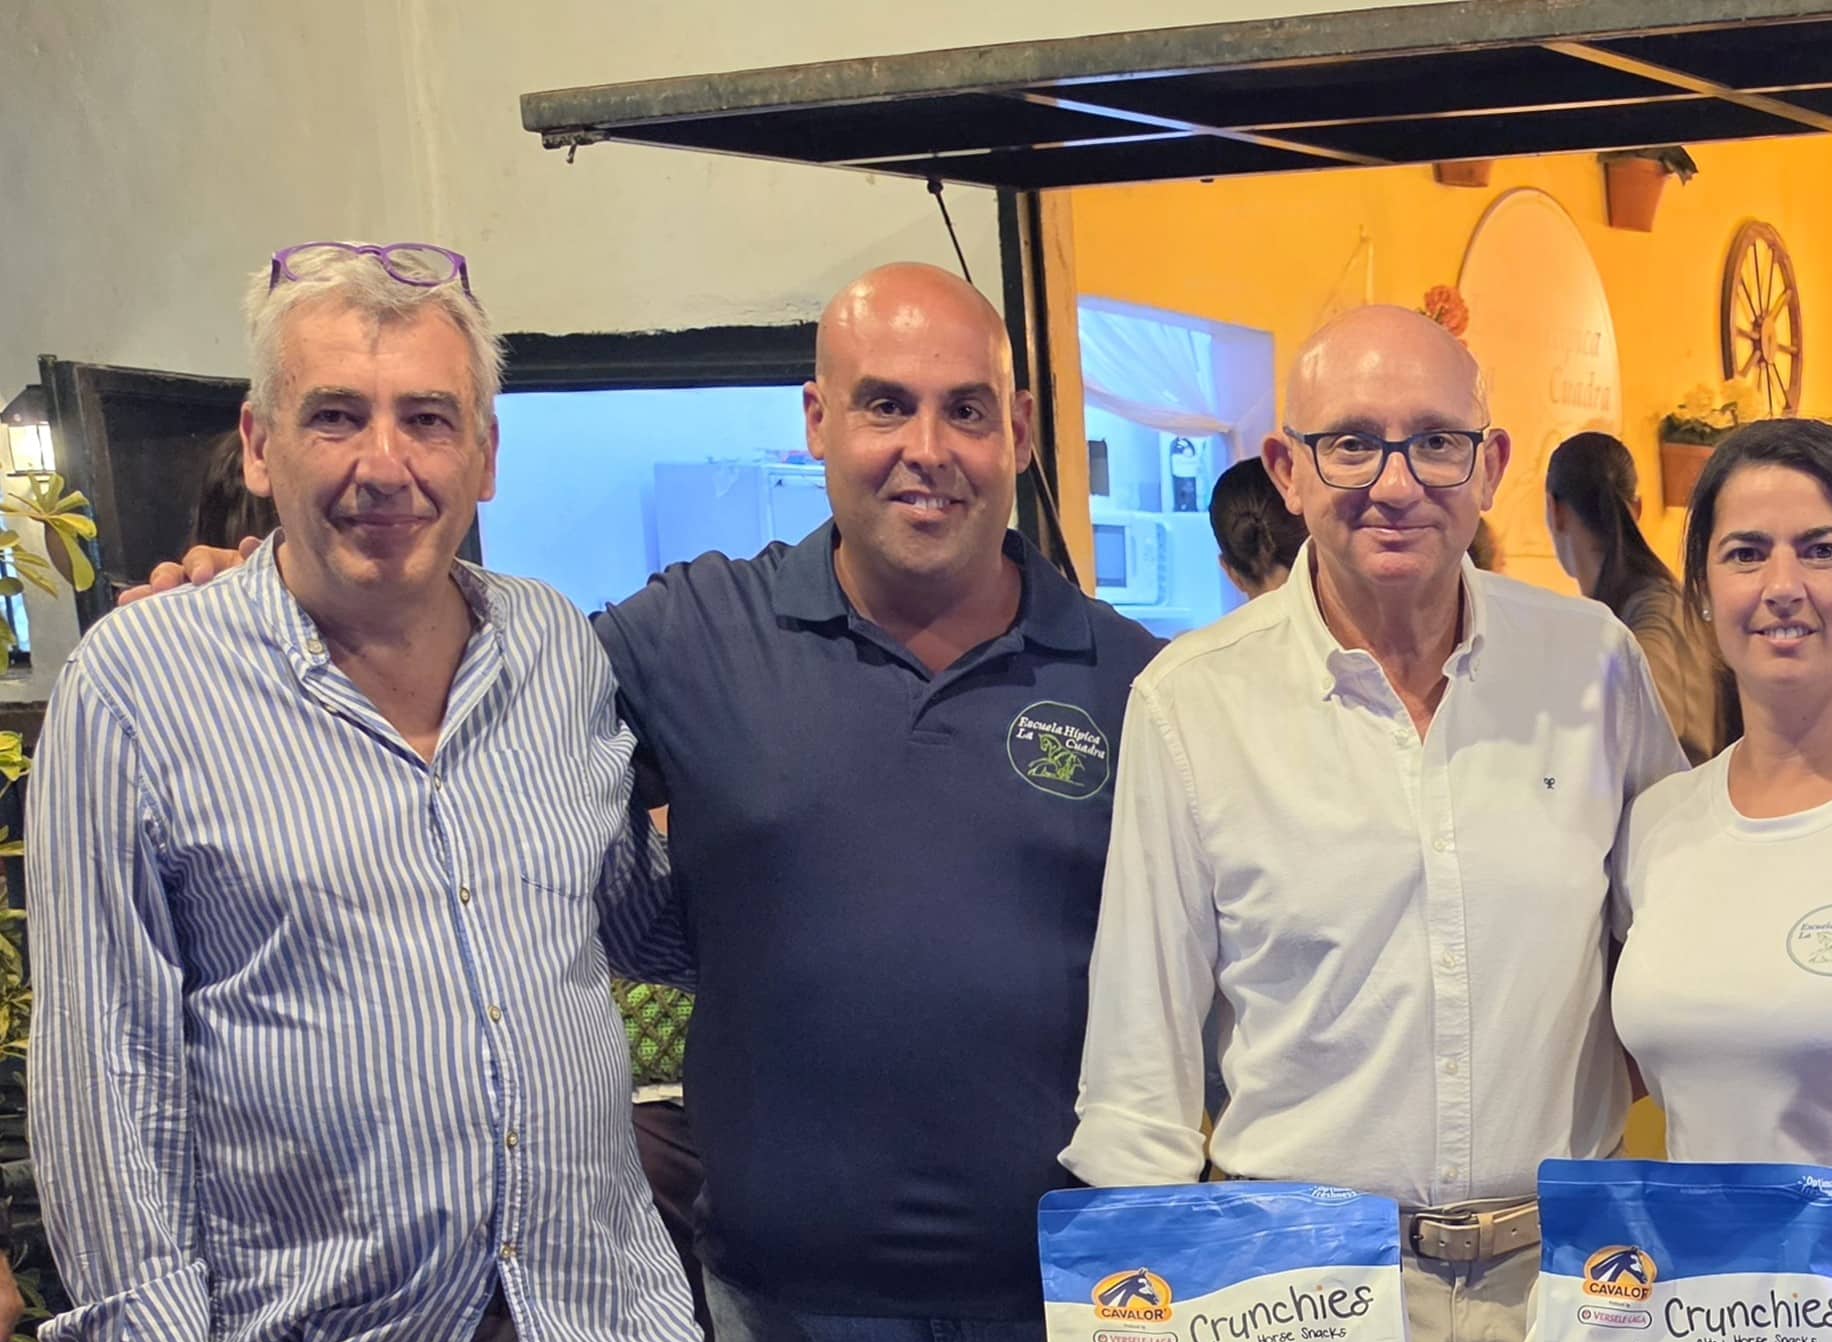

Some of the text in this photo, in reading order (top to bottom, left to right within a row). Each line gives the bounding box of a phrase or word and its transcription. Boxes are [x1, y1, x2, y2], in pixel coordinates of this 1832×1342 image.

[1018, 717, 1063, 734] Escuela
[1016, 728, 1105, 759] La Cuadra
[1101, 1308, 1164, 1321] CAVALOR
[1301, 1327, 1347, 1340] Snacks
